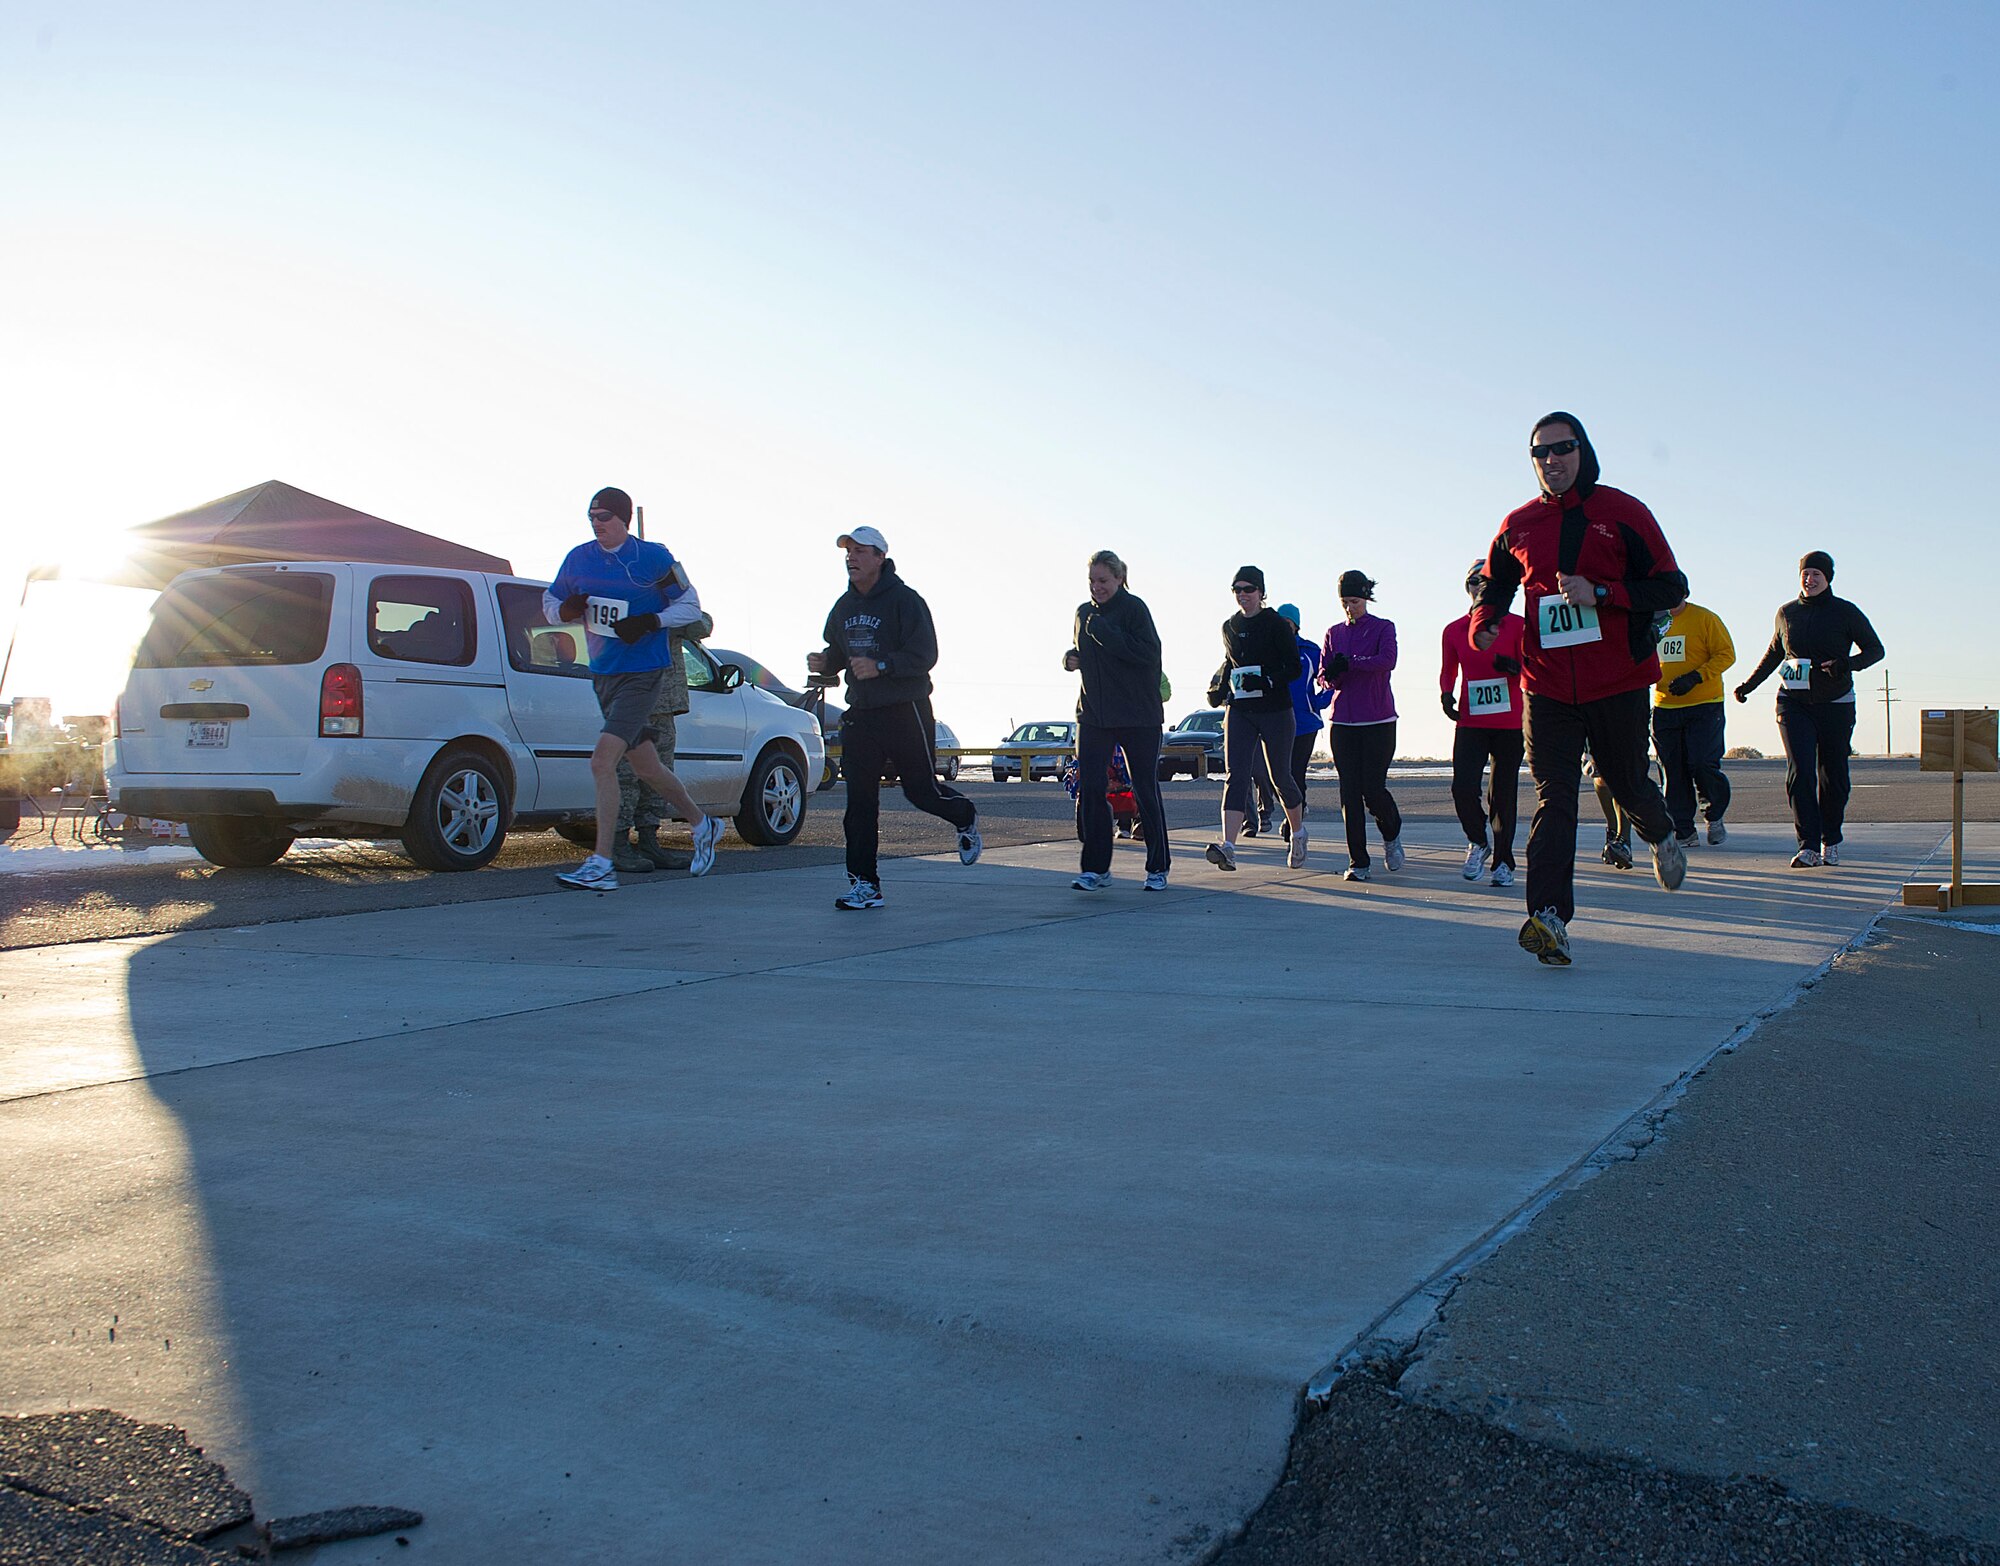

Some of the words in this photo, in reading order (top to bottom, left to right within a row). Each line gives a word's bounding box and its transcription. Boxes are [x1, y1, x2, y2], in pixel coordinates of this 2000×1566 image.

[592, 604, 619, 627] 199
[859, 614, 882, 629] FORCE
[1548, 603, 1584, 633] 201
[1663, 641, 1682, 655] 062
[1783, 664, 1803, 681] 200
[1476, 684, 1502, 705] 203
